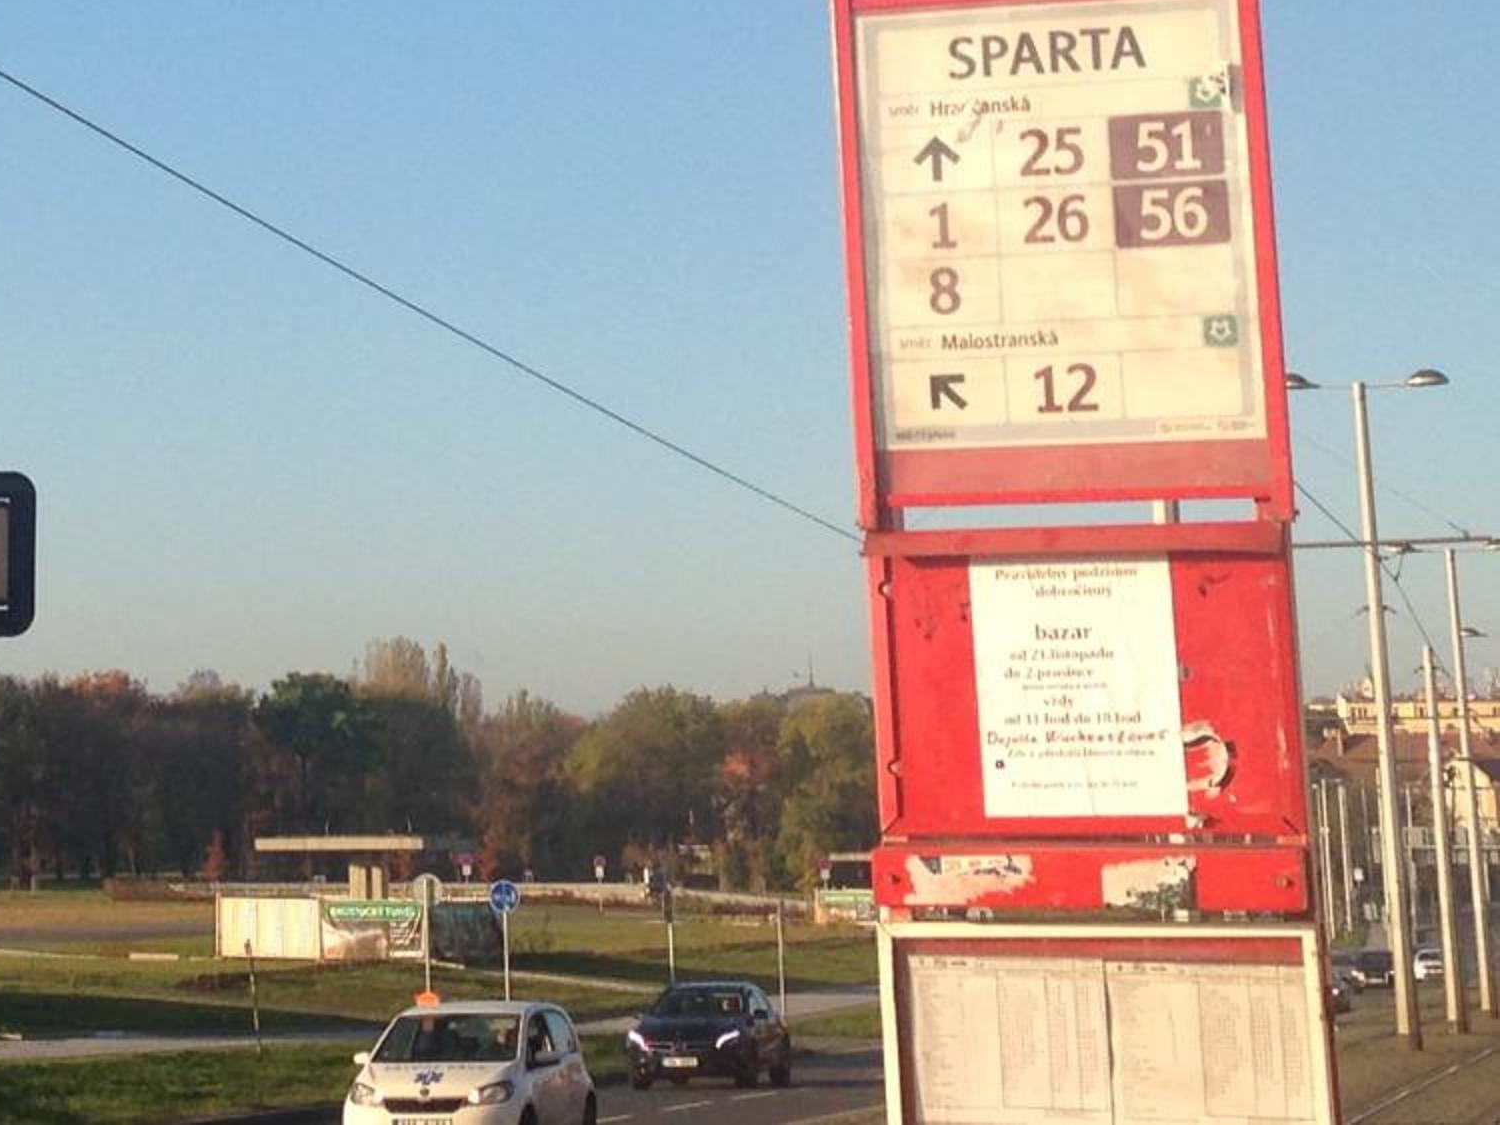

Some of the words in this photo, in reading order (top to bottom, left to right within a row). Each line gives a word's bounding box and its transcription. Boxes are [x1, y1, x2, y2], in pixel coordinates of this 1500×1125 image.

[949, 25, 1147, 80] SPARTA
[1019, 127, 1085, 176] 25
[1136, 120, 1202, 172] 51
[929, 202, 958, 249] 1
[1023, 194, 1089, 244] 26
[1140, 187, 1208, 240] 56
[929, 266, 961, 316] 8
[941, 330, 1059, 351] Malostranská
[1034, 362, 1099, 414] 12
[1035, 624, 1093, 640] bazar
